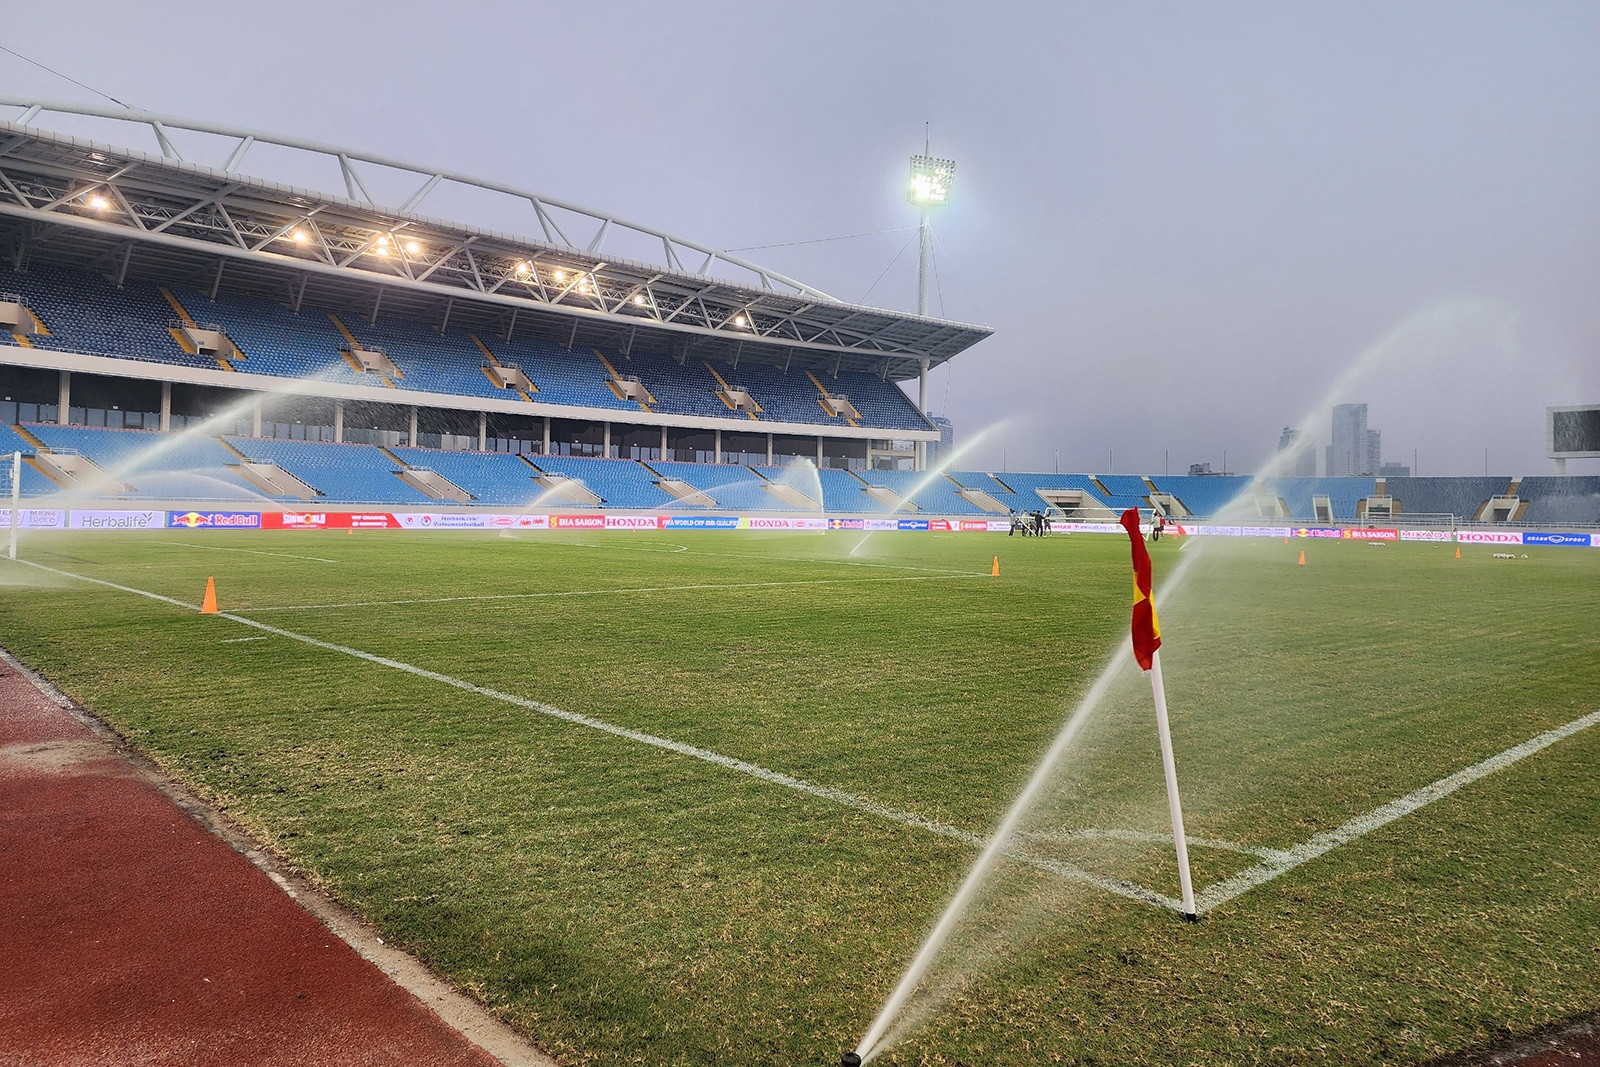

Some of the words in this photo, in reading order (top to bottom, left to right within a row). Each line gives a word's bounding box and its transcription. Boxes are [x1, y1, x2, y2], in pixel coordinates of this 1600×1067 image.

[82, 515, 147, 528] Herbalife
[215, 514, 237, 526] Red
[237, 514, 257, 526] Bull
[559, 518, 574, 526] BIA
[606, 518, 656, 527] HONDA
[1401, 530, 1453, 539] MIKADO
[1459, 533, 1521, 542] HONDA
